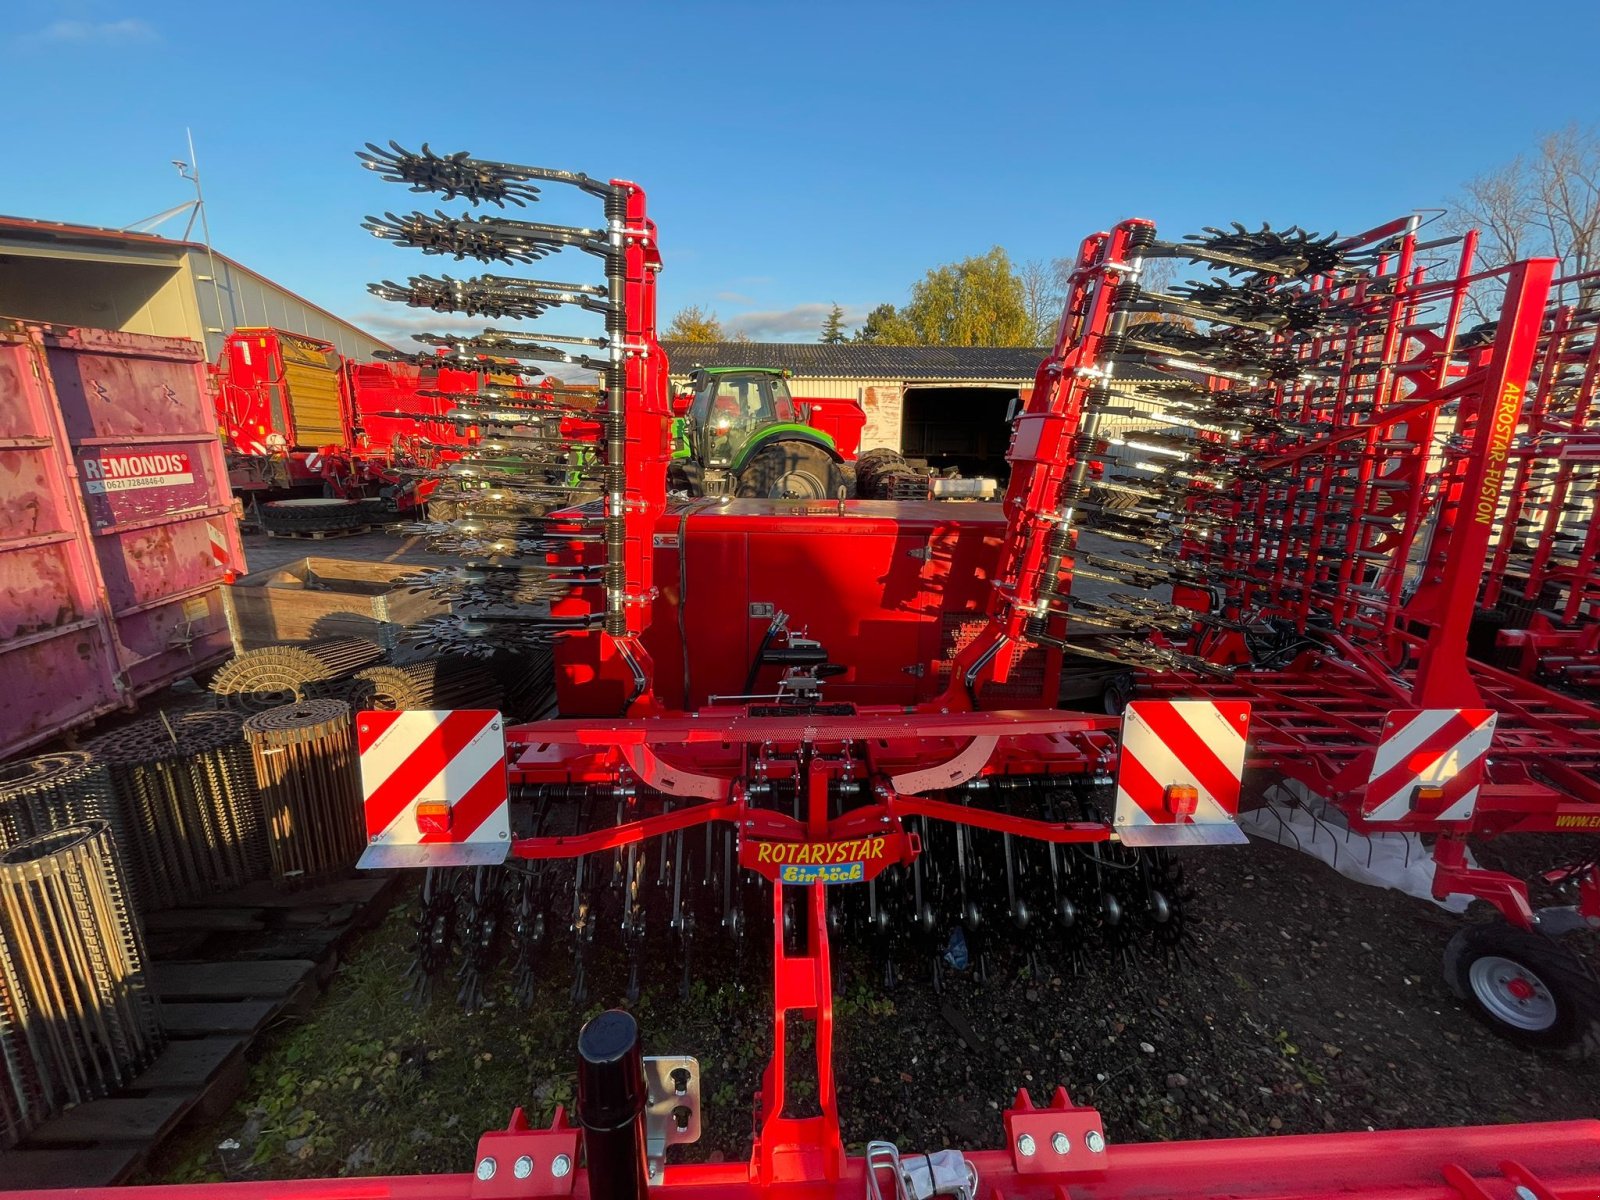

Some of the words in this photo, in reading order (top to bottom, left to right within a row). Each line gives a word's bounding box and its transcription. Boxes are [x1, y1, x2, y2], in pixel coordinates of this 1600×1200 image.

[1474, 382, 1521, 524] AEROSTAR-FUSION
[106, 480, 126, 490] 0621
[128, 476, 165, 488] 7284846-0
[758, 838, 885, 864] ROTARYSTAR
[783, 864, 861, 882] Einböck
